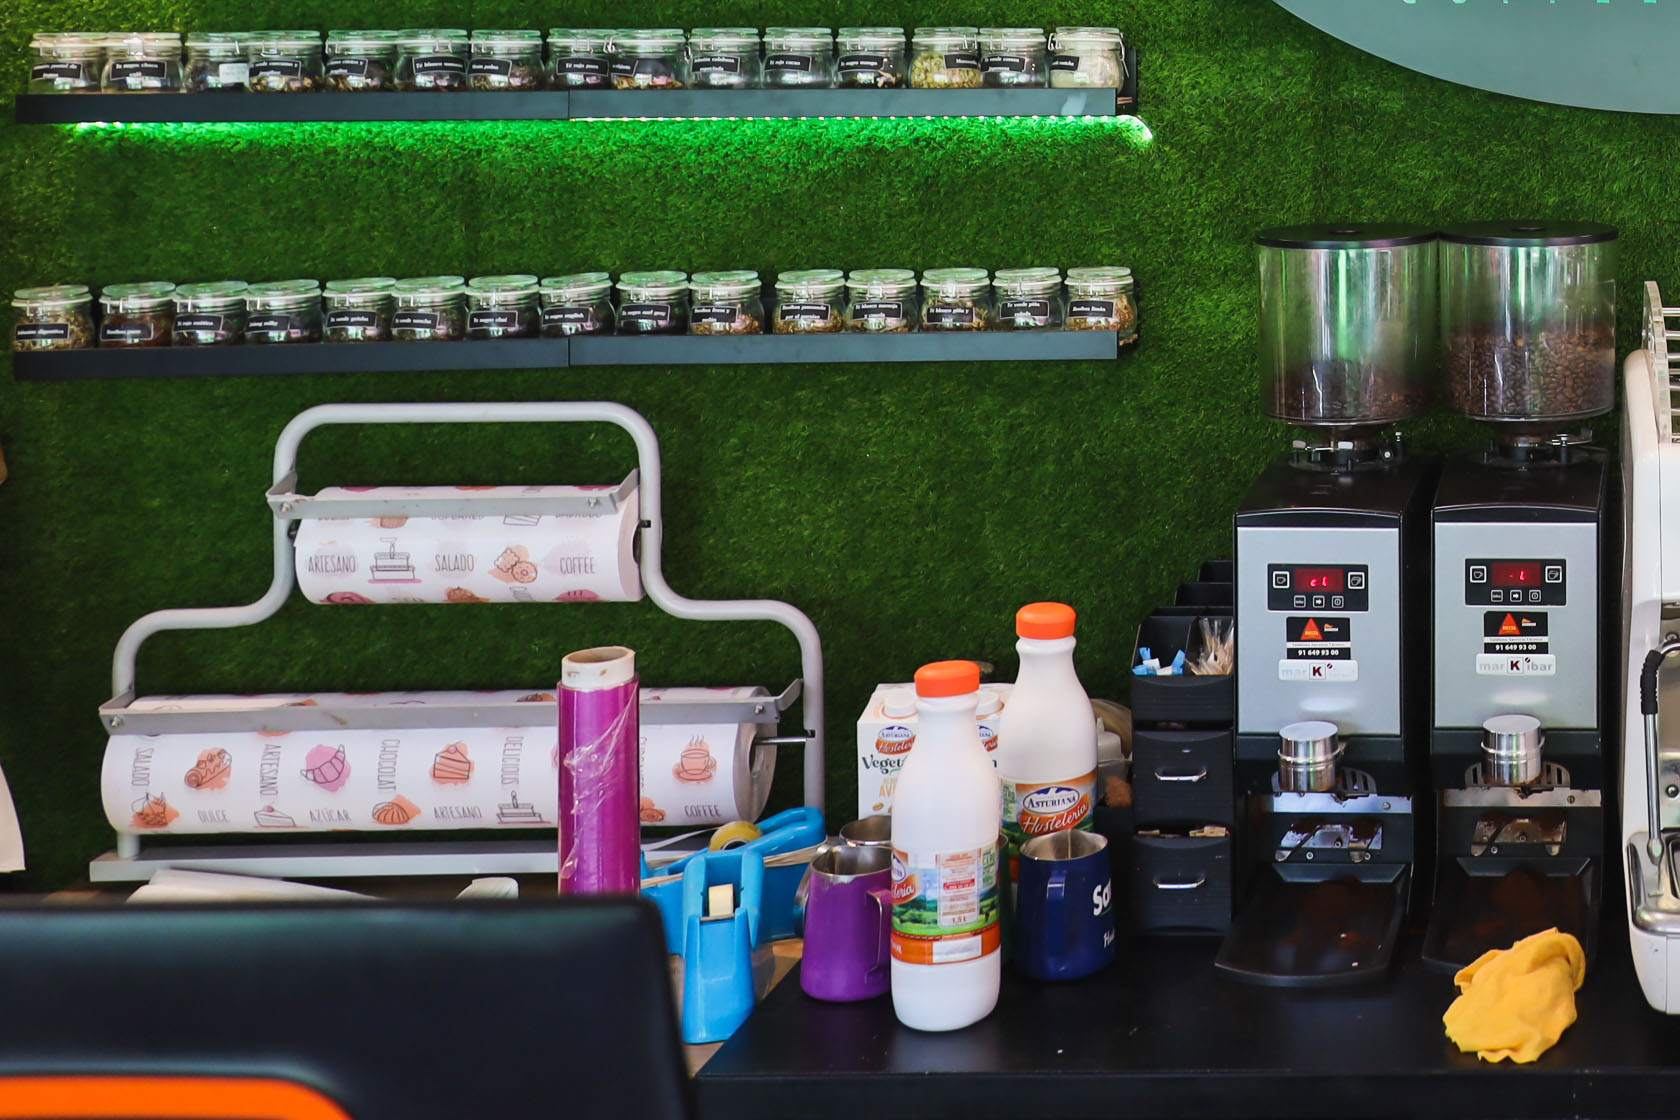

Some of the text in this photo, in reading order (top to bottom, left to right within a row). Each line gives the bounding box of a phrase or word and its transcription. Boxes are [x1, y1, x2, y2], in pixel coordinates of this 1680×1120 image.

[308, 553, 356, 573] ARTESANO
[434, 553, 475, 572] SALADO
[559, 556, 596, 574] COFFEE
[1297, 649, 1339, 657] 91 649 93 00
[1495, 643, 1537, 651] 91 649 93 00
[131, 747, 155, 787] SALADO
[259, 744, 282, 797] ARTESANO
[861, 755, 905, 774] Veget
[1026, 795, 1077, 809] ASTURIANA
[197, 809, 229, 823] DULCE
[433, 806, 483, 820] ARTESANO
[684, 804, 722, 818] COFFEE
